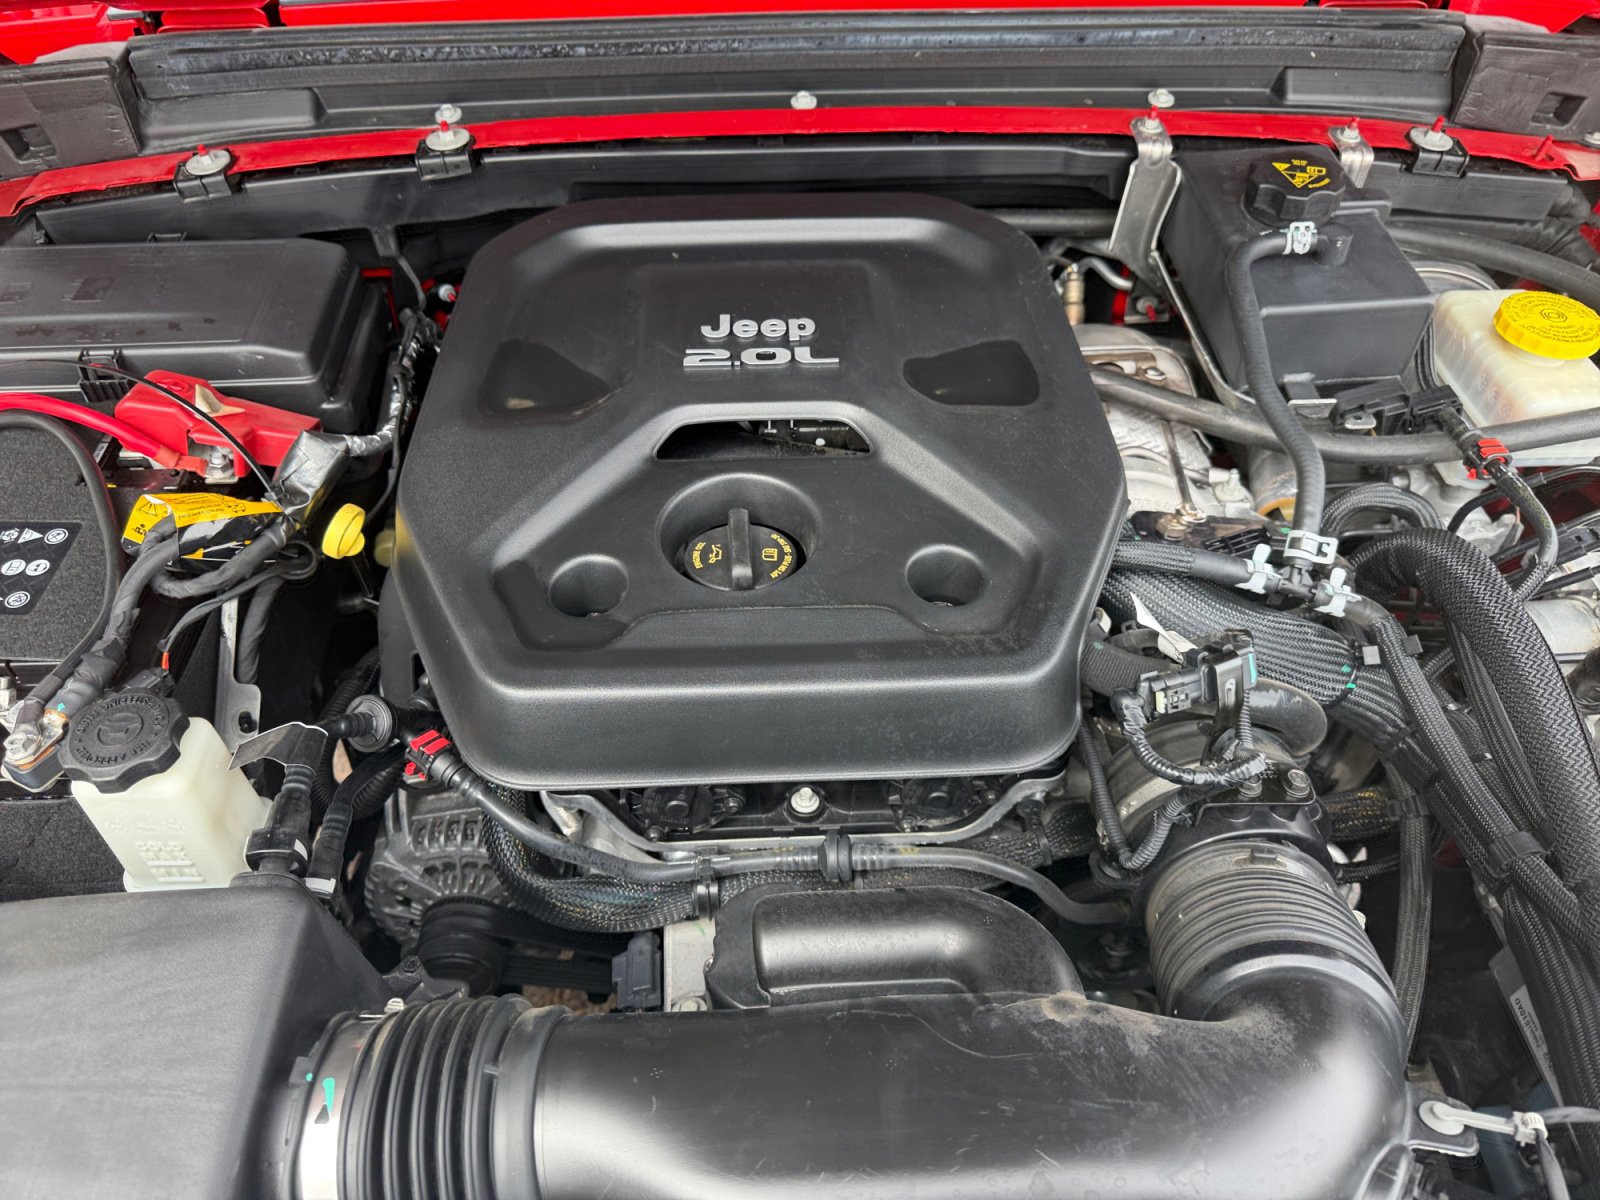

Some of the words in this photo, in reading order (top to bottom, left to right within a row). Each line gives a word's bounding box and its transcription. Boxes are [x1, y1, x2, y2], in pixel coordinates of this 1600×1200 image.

[700, 314, 816, 341] Jeep
[683, 346, 840, 366] 2.0L
[134, 840, 186, 852] COLD
